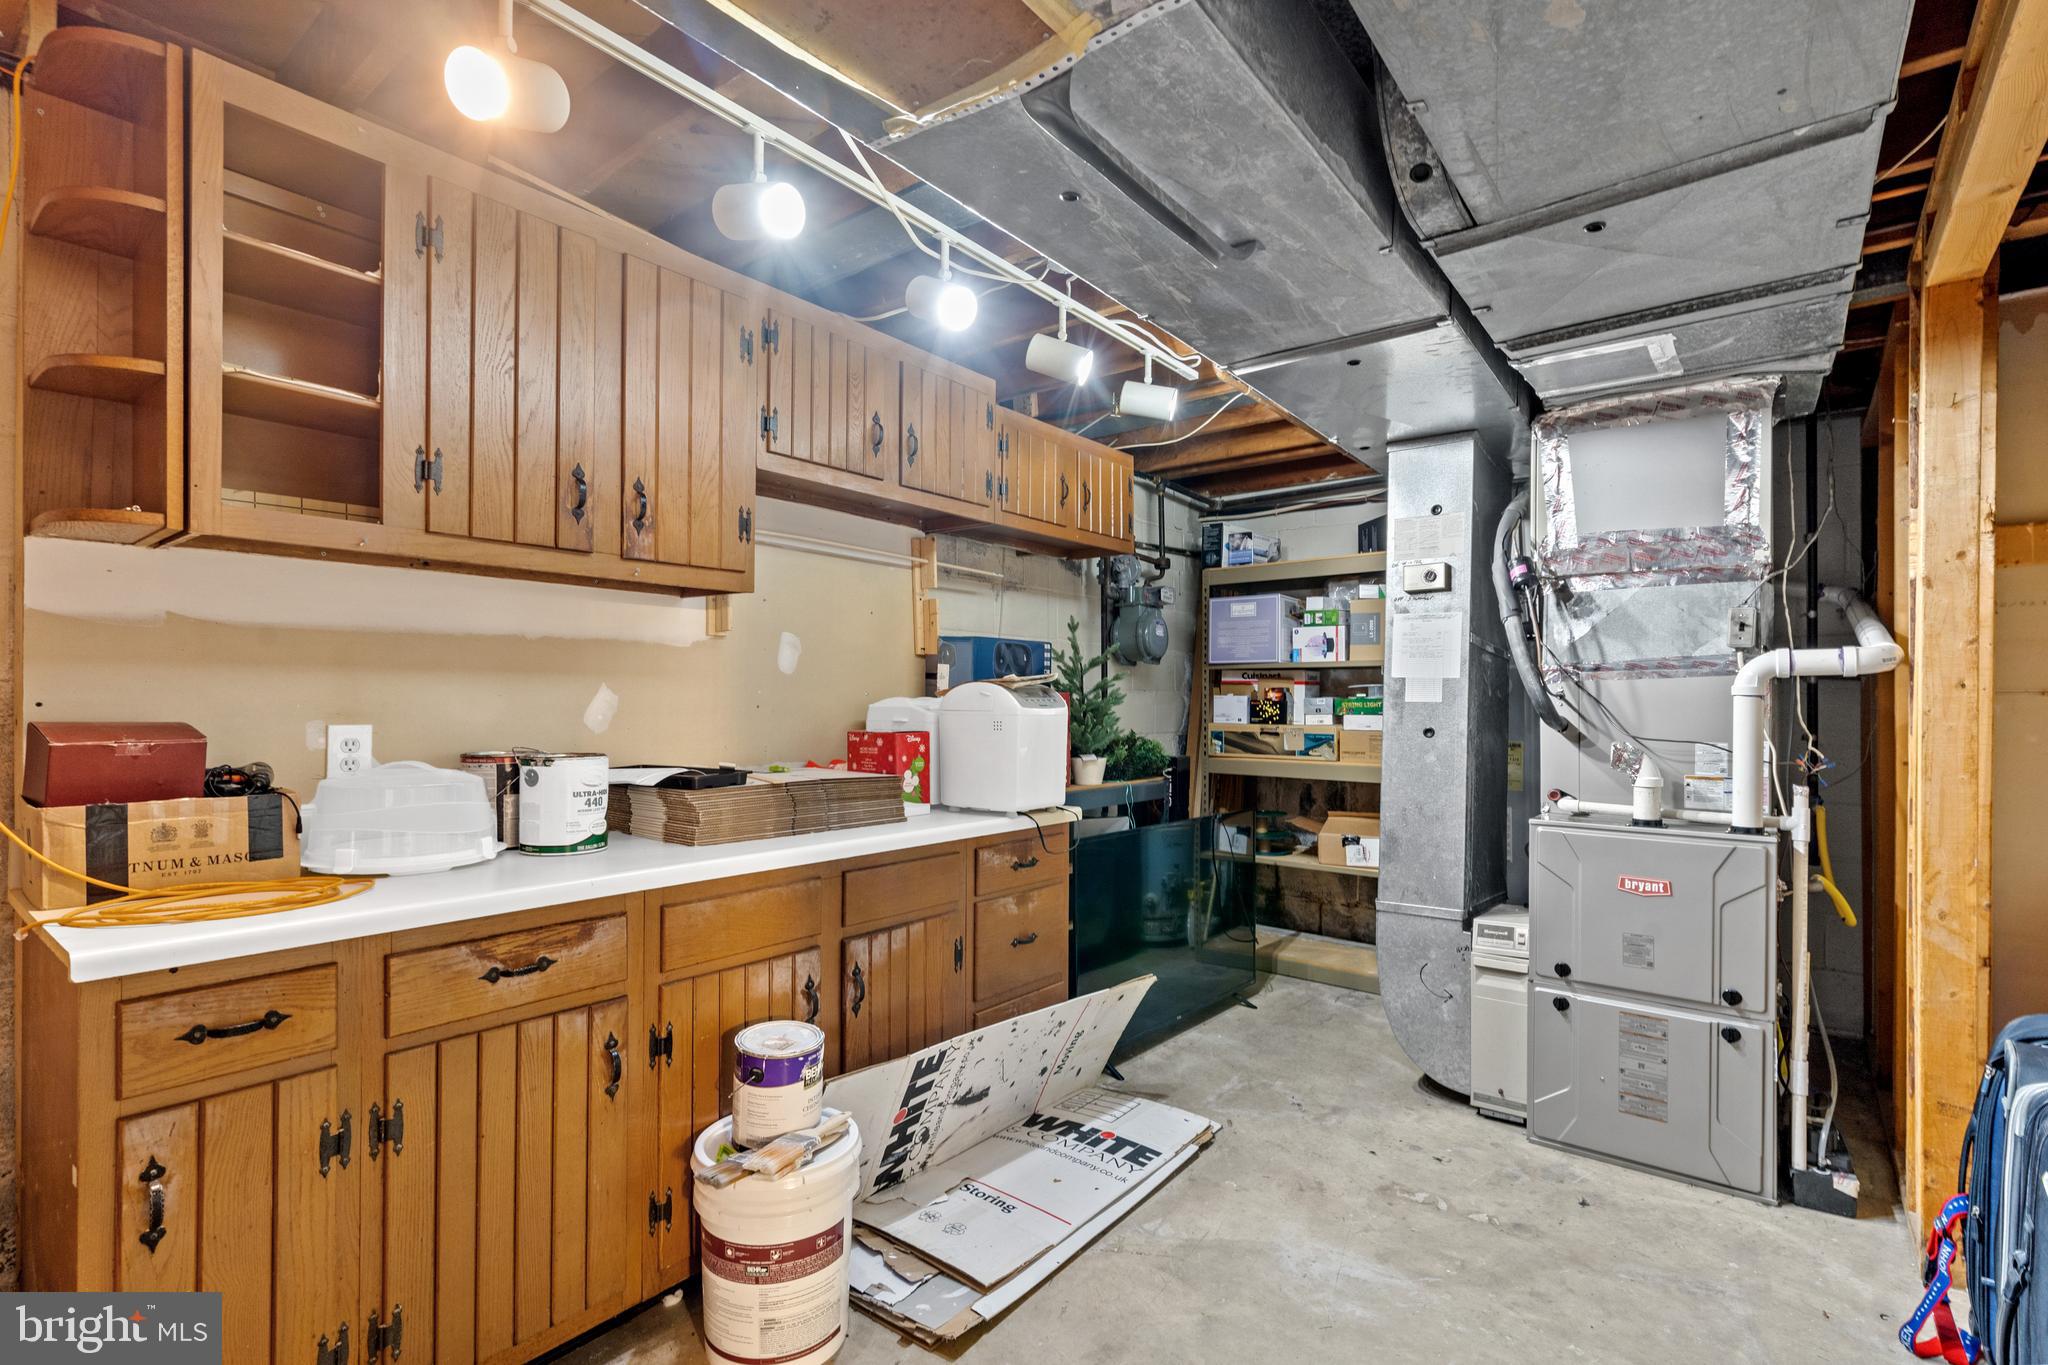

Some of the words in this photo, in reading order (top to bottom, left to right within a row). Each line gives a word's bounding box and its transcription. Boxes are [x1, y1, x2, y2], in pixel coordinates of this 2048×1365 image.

[572, 789, 607, 798] ULTRA-HID
[584, 796, 603, 807] 440
[128, 857, 184, 873] TNUM
[190, 857, 202, 867] &
[207, 852, 250, 866] MAS
[1624, 878, 1665, 893] bryant
[1053, 1029, 1084, 1075] Moving
[1027, 1130, 1144, 1174] COMPANY
[959, 1183, 1018, 1214] Storing
